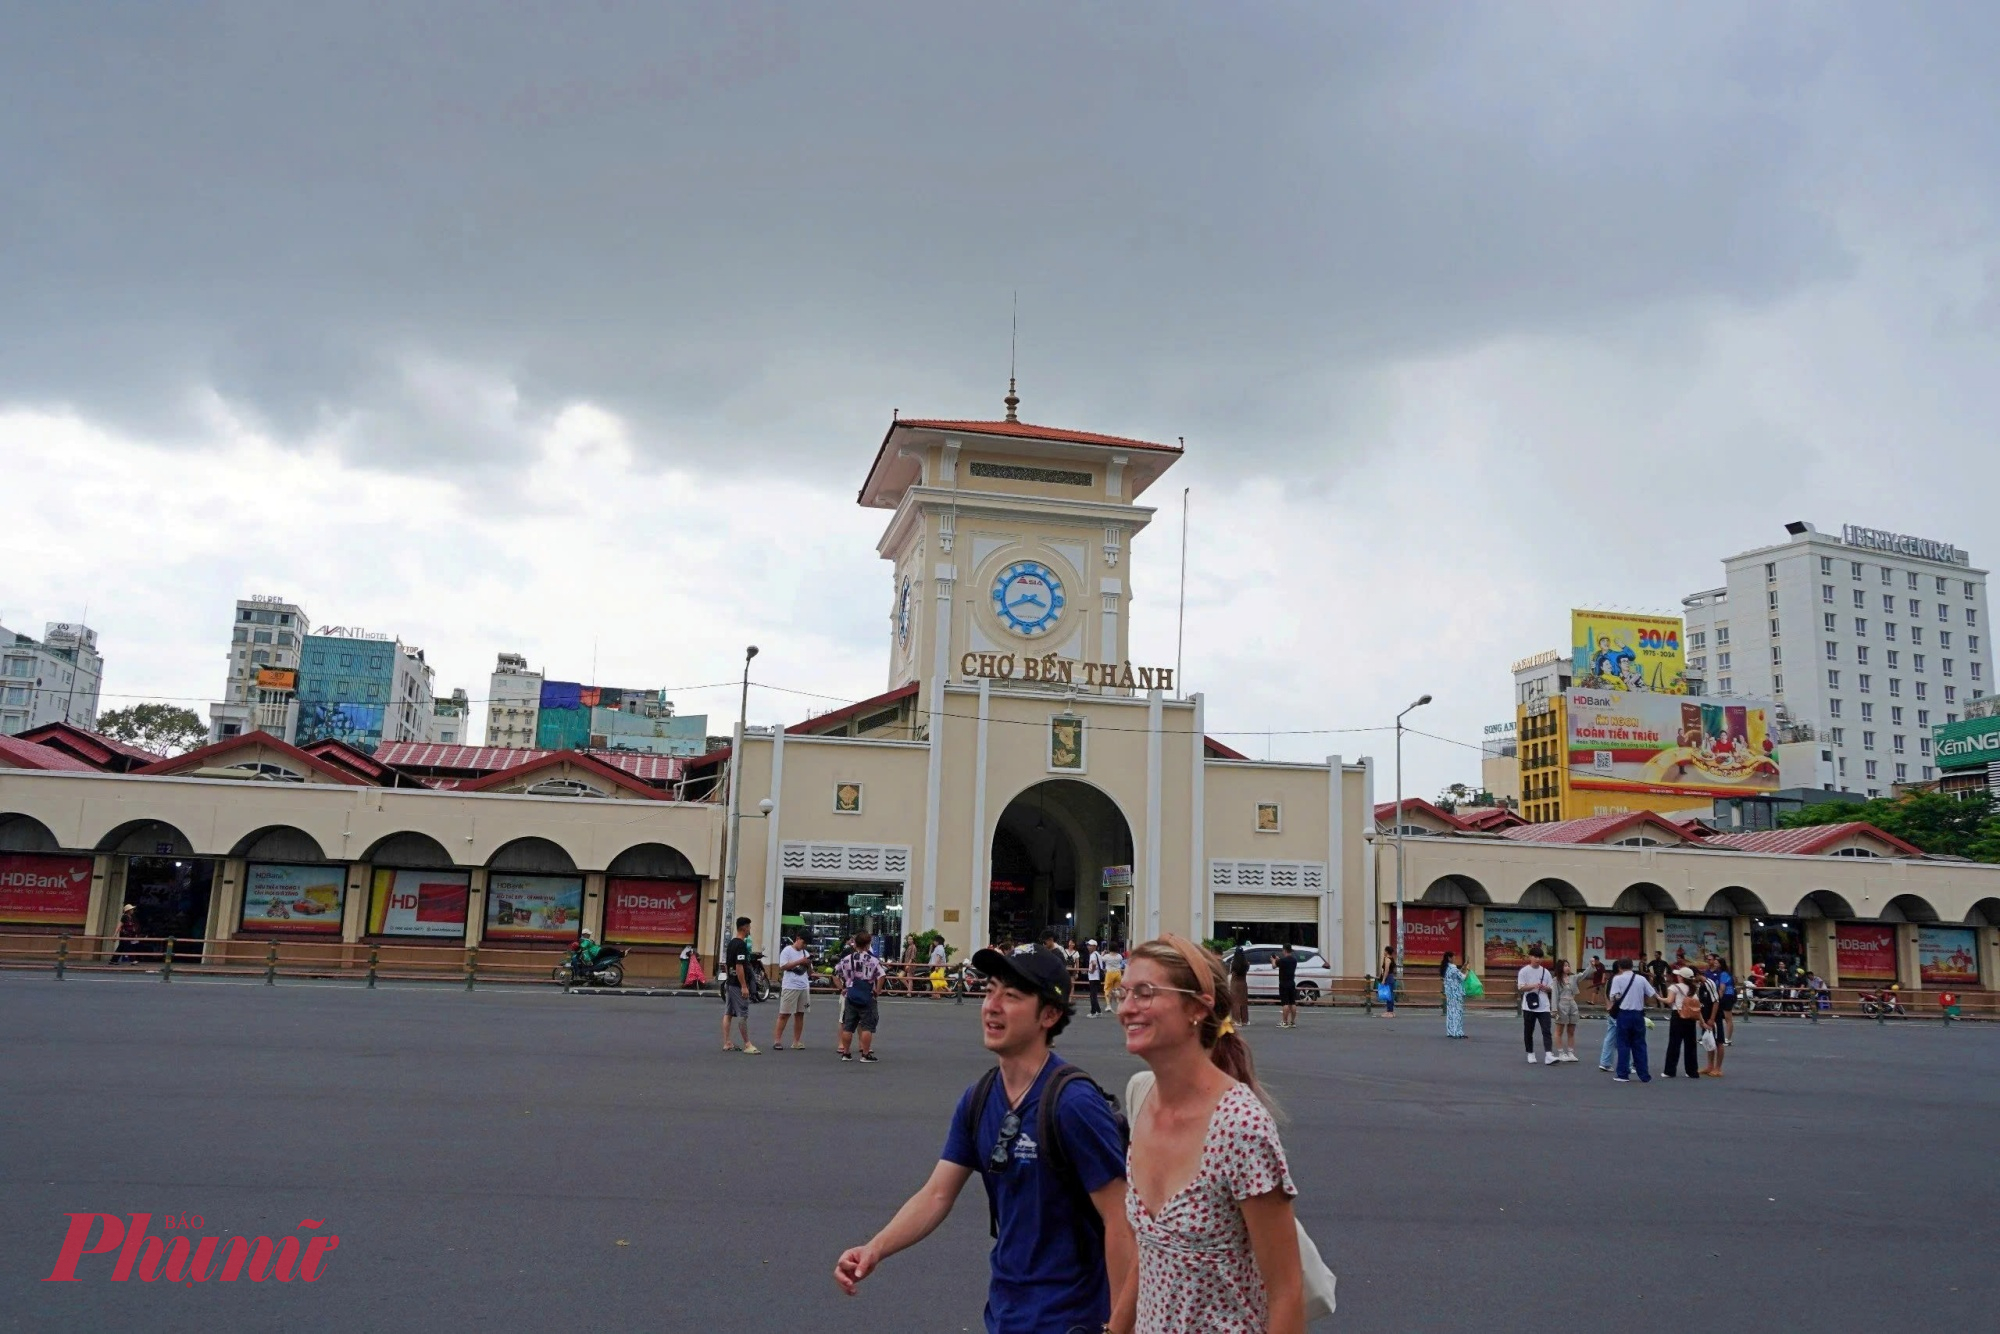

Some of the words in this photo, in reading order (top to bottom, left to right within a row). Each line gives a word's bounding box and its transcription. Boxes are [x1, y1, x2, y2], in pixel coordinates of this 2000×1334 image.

[1843, 523, 1899, 553] LIBERTY
[1898, 533, 1956, 563] CENTRAL
[252, 594, 283, 604] GOLDEN
[313, 625, 364, 639] AVANTI
[1637, 628, 1680, 651] 30/4
[960, 652, 1015, 678] CHỢ
[1024, 652, 1074, 683] BẾN
[1082, 659, 1174, 691] THÀNH
[1573, 695, 1611, 707] HDBank
[0, 872, 68, 889] HDBank
[391, 894, 418, 910] HD
[617, 894, 676, 910] HDBank
[1837, 938, 1880, 951] HDBank
